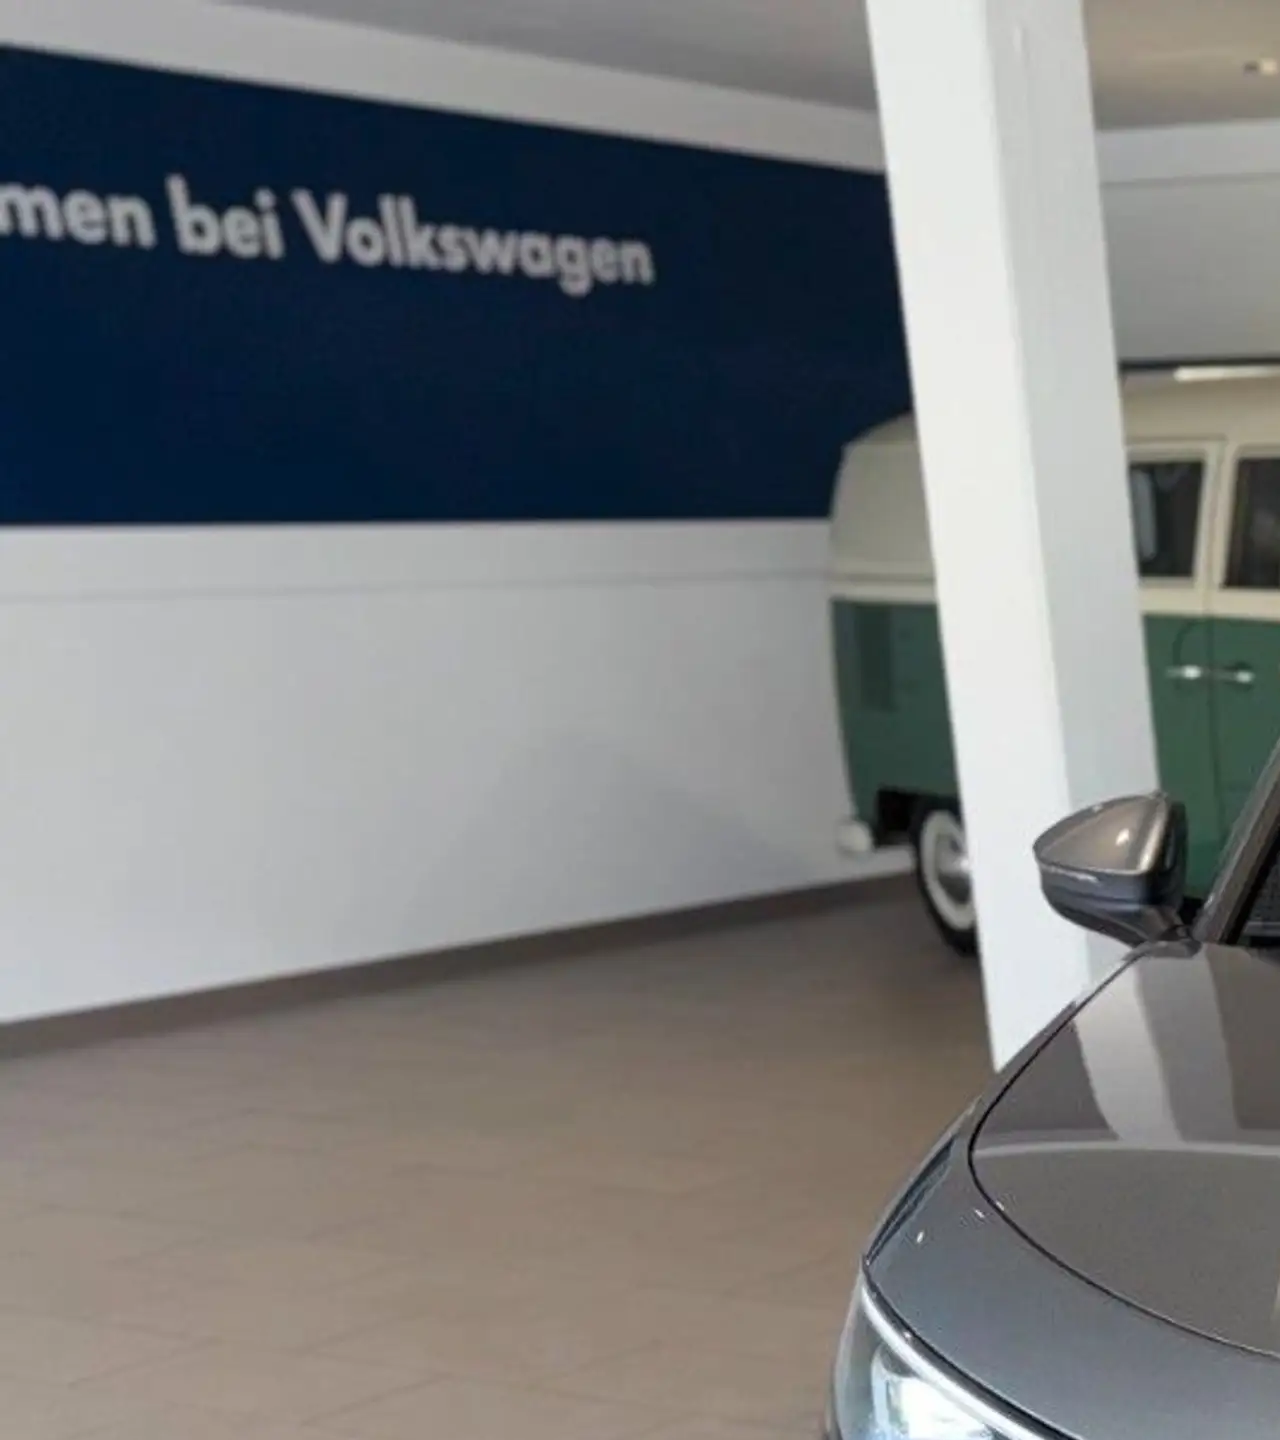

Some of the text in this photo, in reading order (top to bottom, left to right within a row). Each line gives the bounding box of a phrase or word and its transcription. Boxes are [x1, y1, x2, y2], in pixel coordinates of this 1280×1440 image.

[0, 172, 655, 298] men bei Volkswagen
